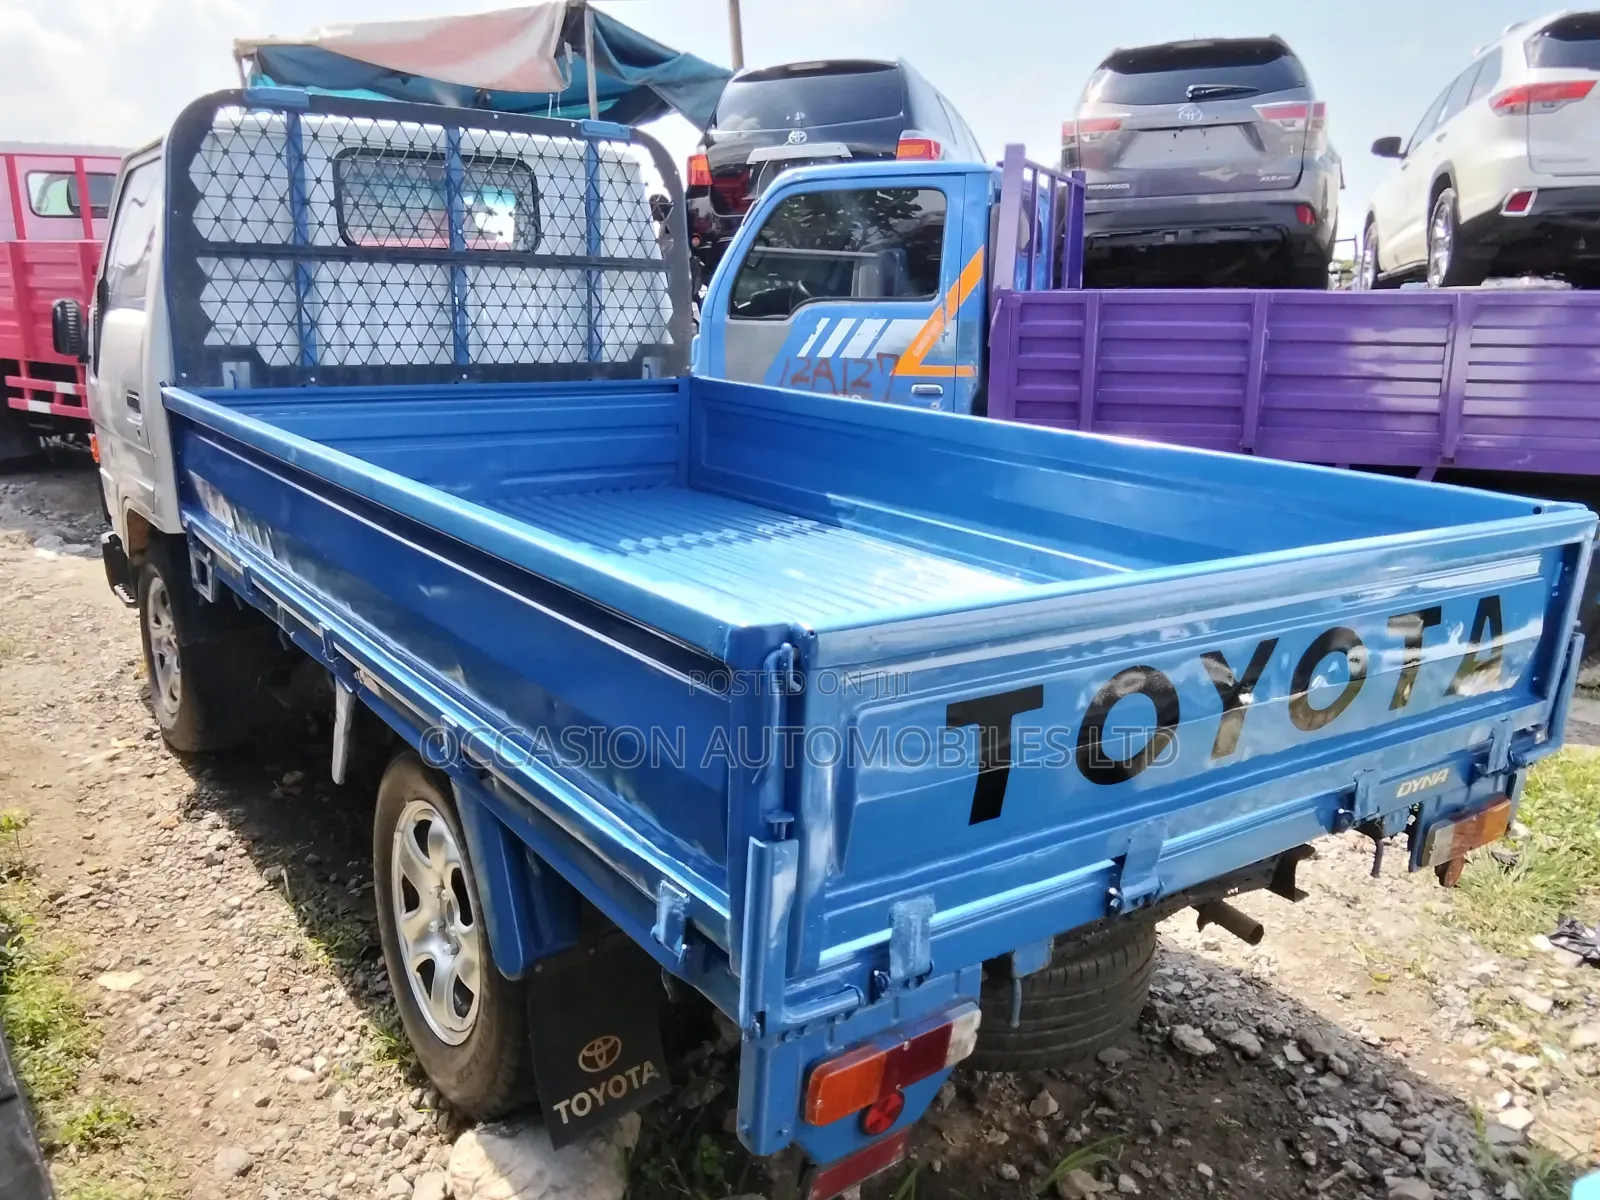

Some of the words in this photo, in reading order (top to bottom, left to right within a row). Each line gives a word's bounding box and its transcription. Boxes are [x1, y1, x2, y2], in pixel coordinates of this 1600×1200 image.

[946, 595, 1506, 826] TOYOTA
[1396, 768, 1450, 798] DYNA
[552, 1060, 661, 1125] TOYOTA
